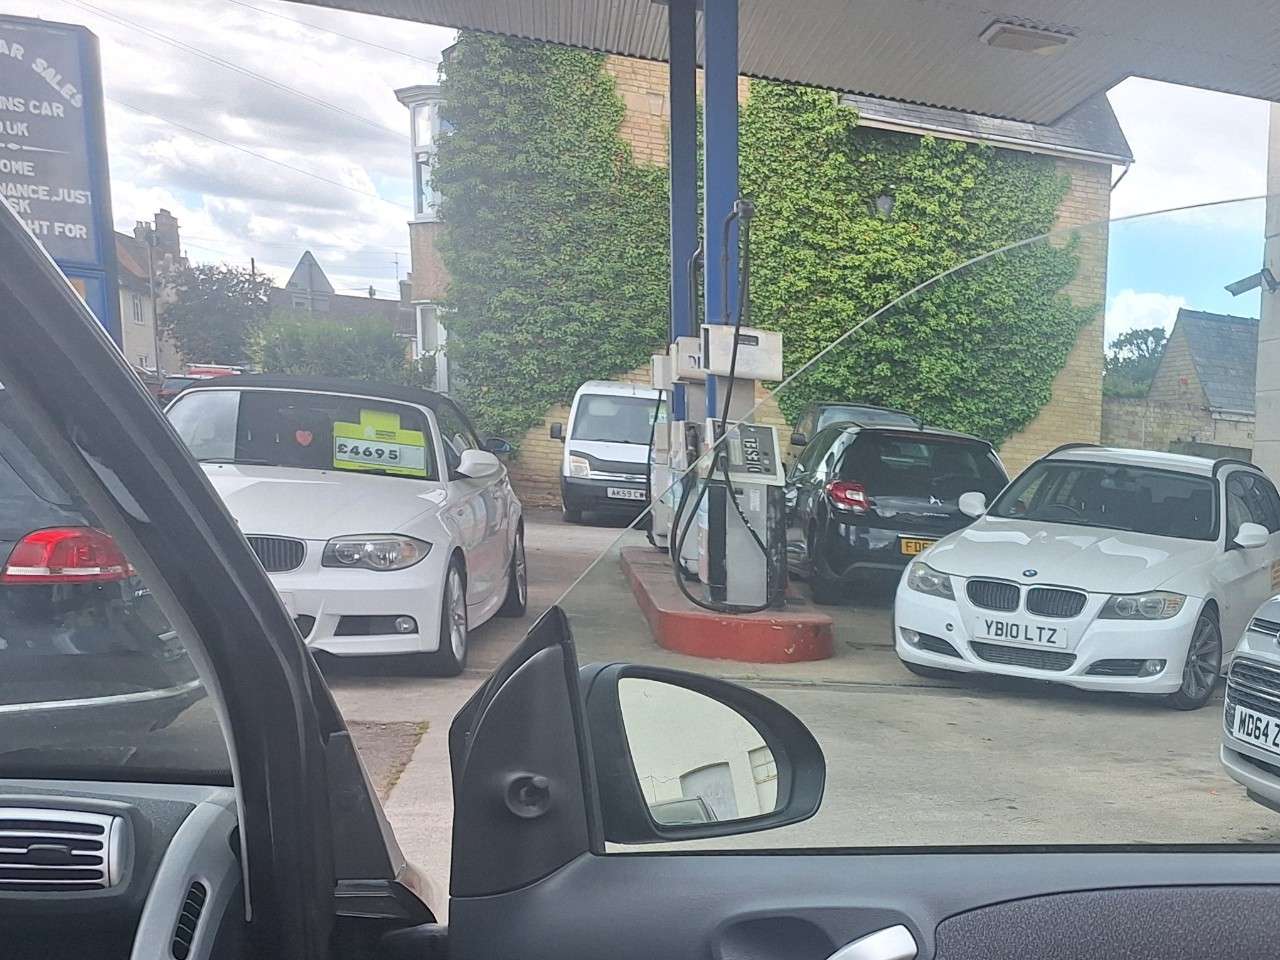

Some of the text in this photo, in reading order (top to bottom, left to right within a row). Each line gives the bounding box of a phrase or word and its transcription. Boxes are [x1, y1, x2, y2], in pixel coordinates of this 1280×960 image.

[32, 57, 82, 108] SALES
[29, 100, 64, 118] CAR
[54, 222, 87, 239] FOR
[337, 443, 398, 460] £4695
[744, 437, 761, 473] DIESEL
[985, 619, 1058, 644] YB10 LTZ
[1238, 710, 1270, 743] MD64
